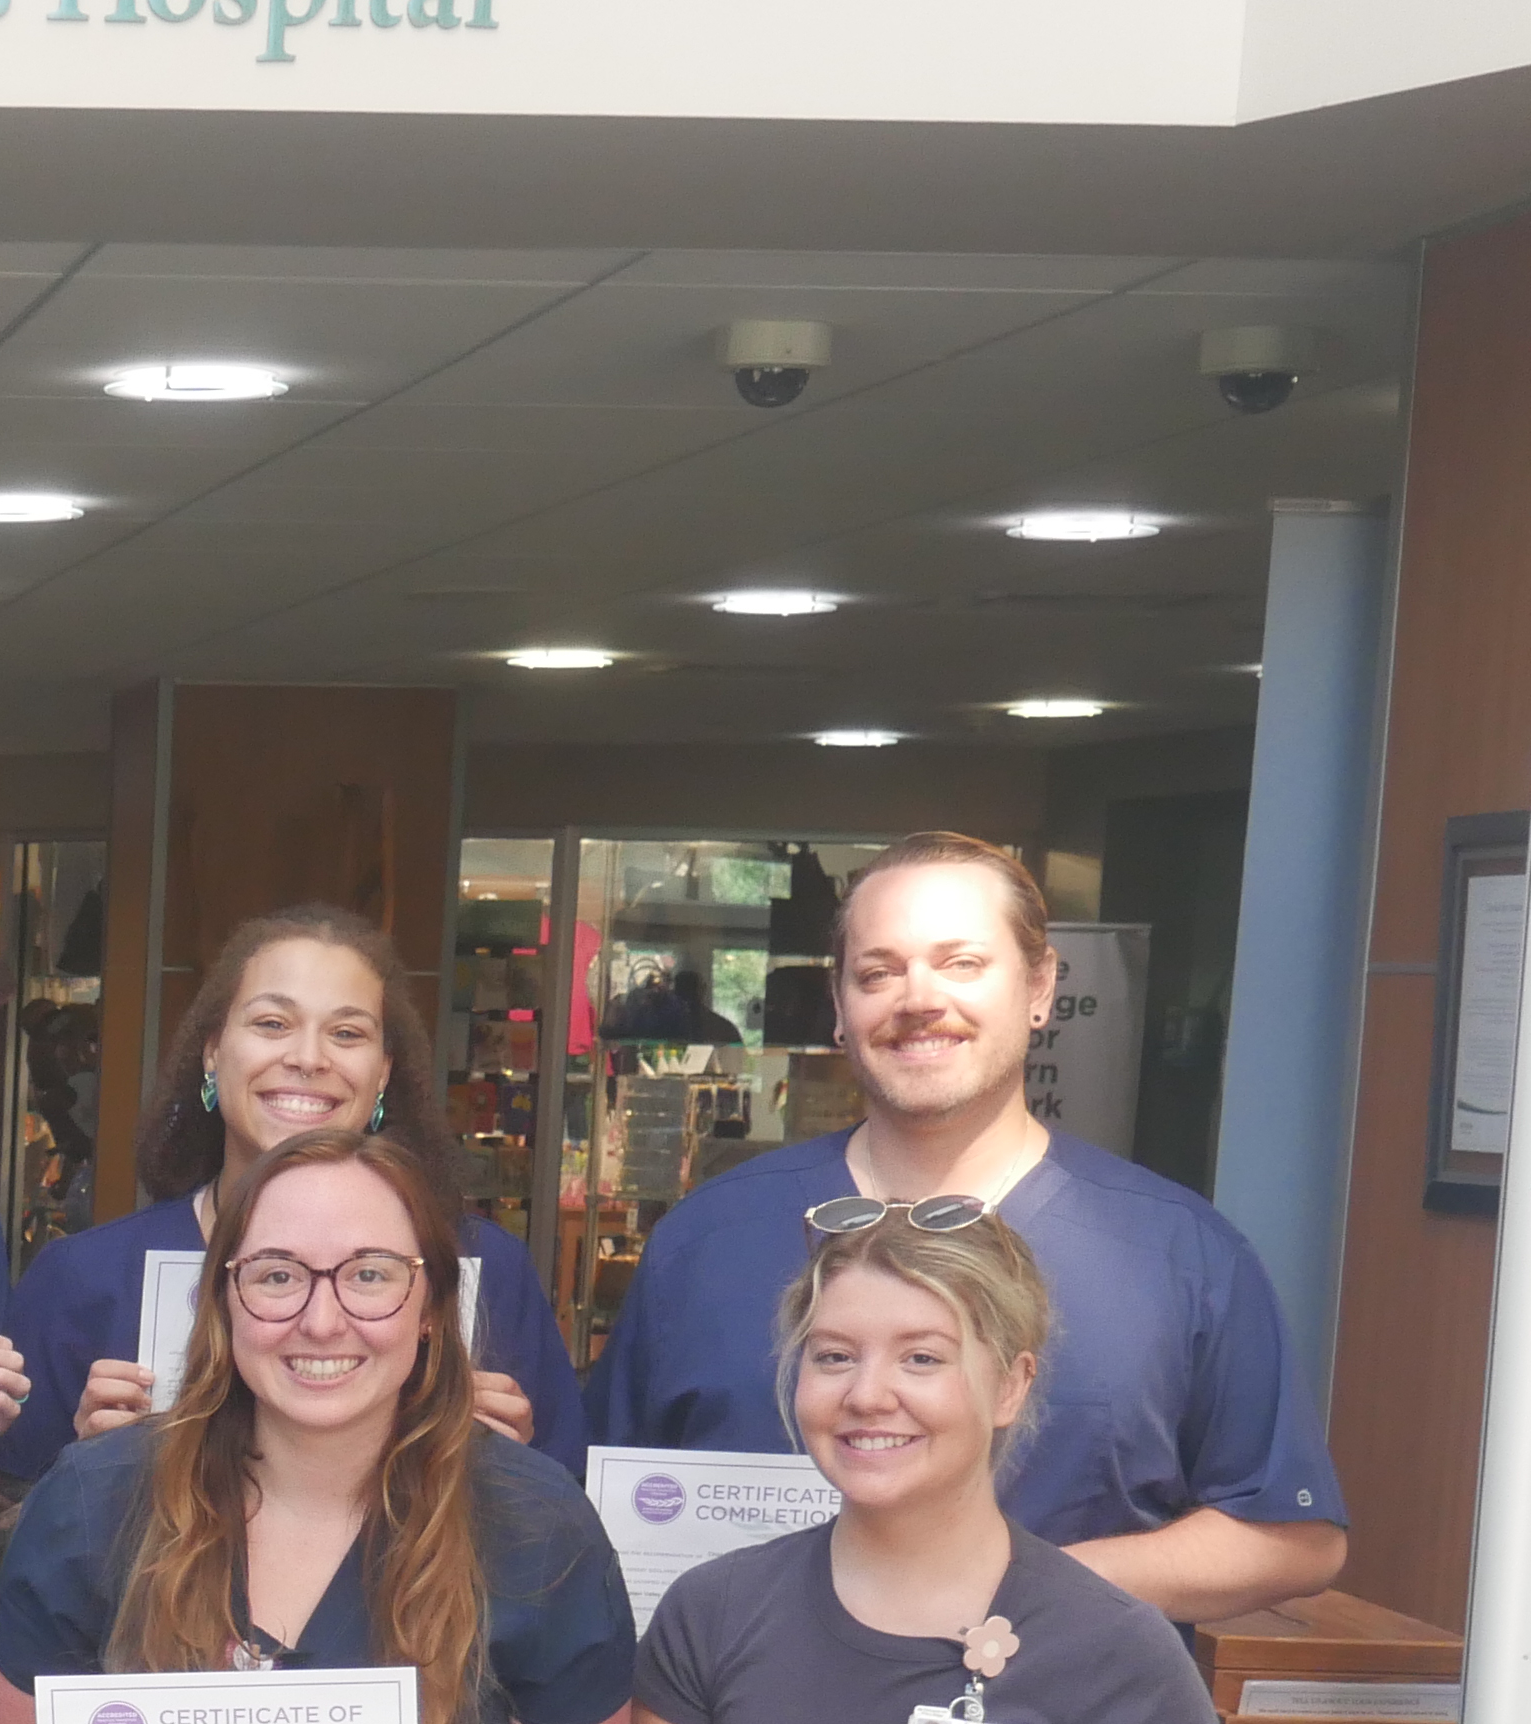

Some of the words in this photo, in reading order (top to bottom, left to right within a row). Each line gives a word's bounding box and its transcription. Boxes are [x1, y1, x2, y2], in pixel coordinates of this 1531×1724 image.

[1028, 1029, 1060, 1049] or
[697, 1484, 842, 1505] CERTIFICATE
[329, 1705, 363, 1722] OF
